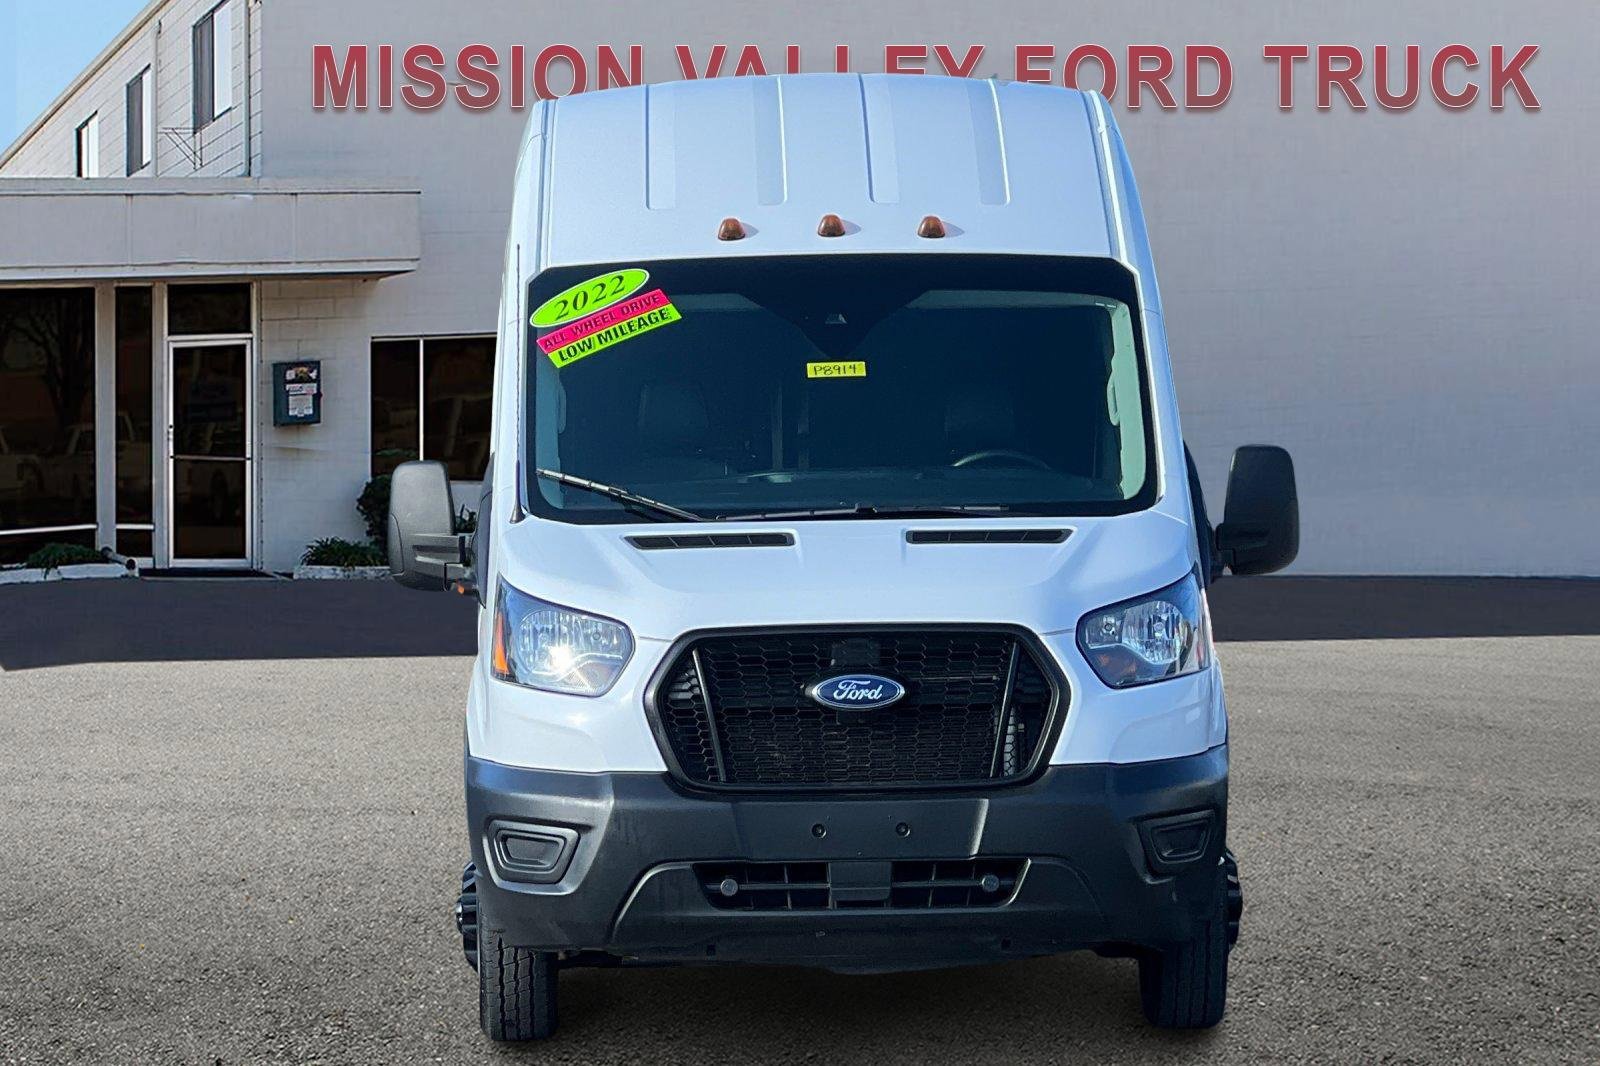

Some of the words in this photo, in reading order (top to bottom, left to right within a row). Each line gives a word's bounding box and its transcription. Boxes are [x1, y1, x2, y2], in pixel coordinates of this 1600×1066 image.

[312, 43, 644, 109] MISSION
[1014, 43, 1234, 109] FORD
[1263, 43, 1542, 109] TRUCK
[544, 331, 567, 350] ALL
[572, 312, 617, 337] WHEEL
[620, 294, 660, 316] DRIVE
[554, 274, 625, 320] 2022
[558, 337, 594, 362] LOW
[597, 307, 670, 346] MILEAGE
[813, 363, 857, 376] P8914
[833, 679, 883, 700] Ford
